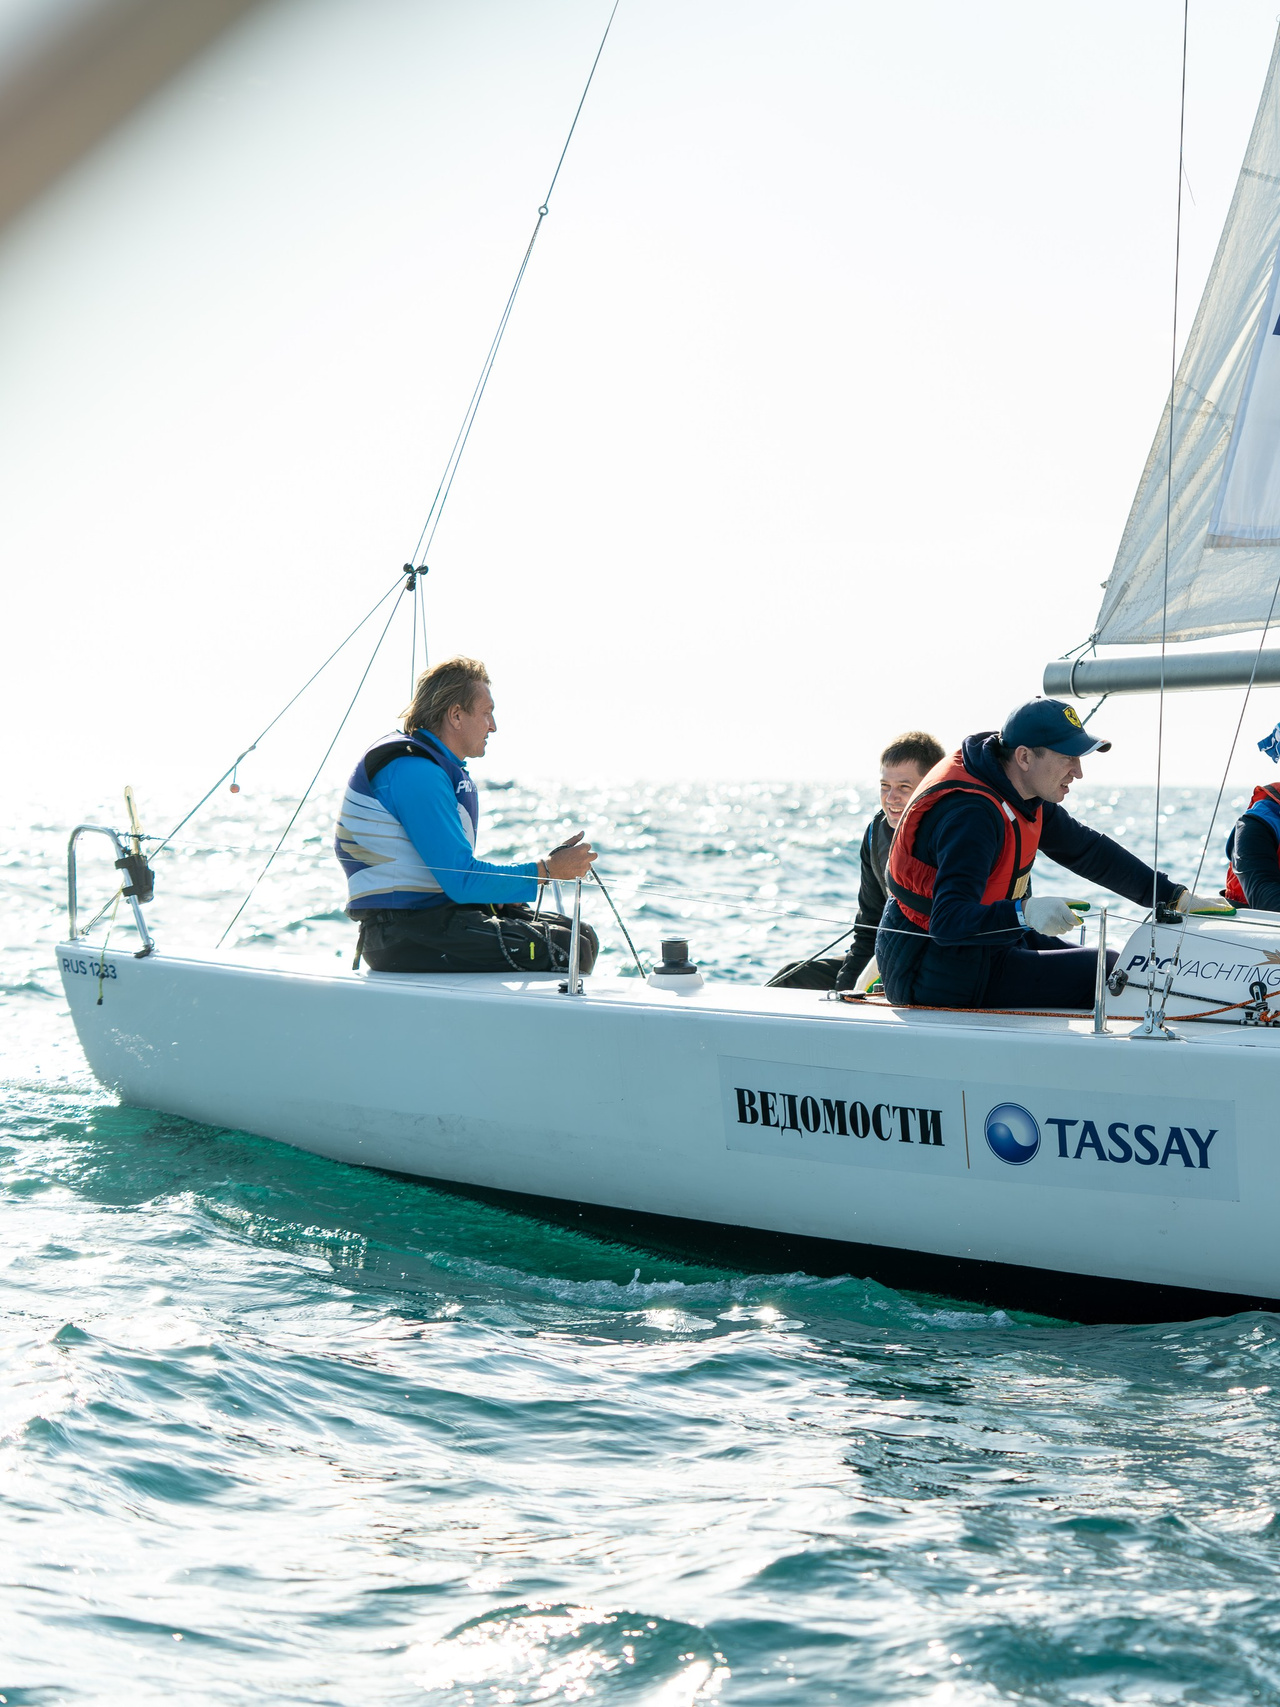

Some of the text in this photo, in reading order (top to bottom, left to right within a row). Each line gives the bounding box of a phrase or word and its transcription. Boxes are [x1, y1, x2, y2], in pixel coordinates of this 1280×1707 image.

[62, 958, 87, 975] RUS
[734, 1087, 945, 1147] ВЕДОМОСТИ
[1045, 1117, 1219, 1169] TASSAY
